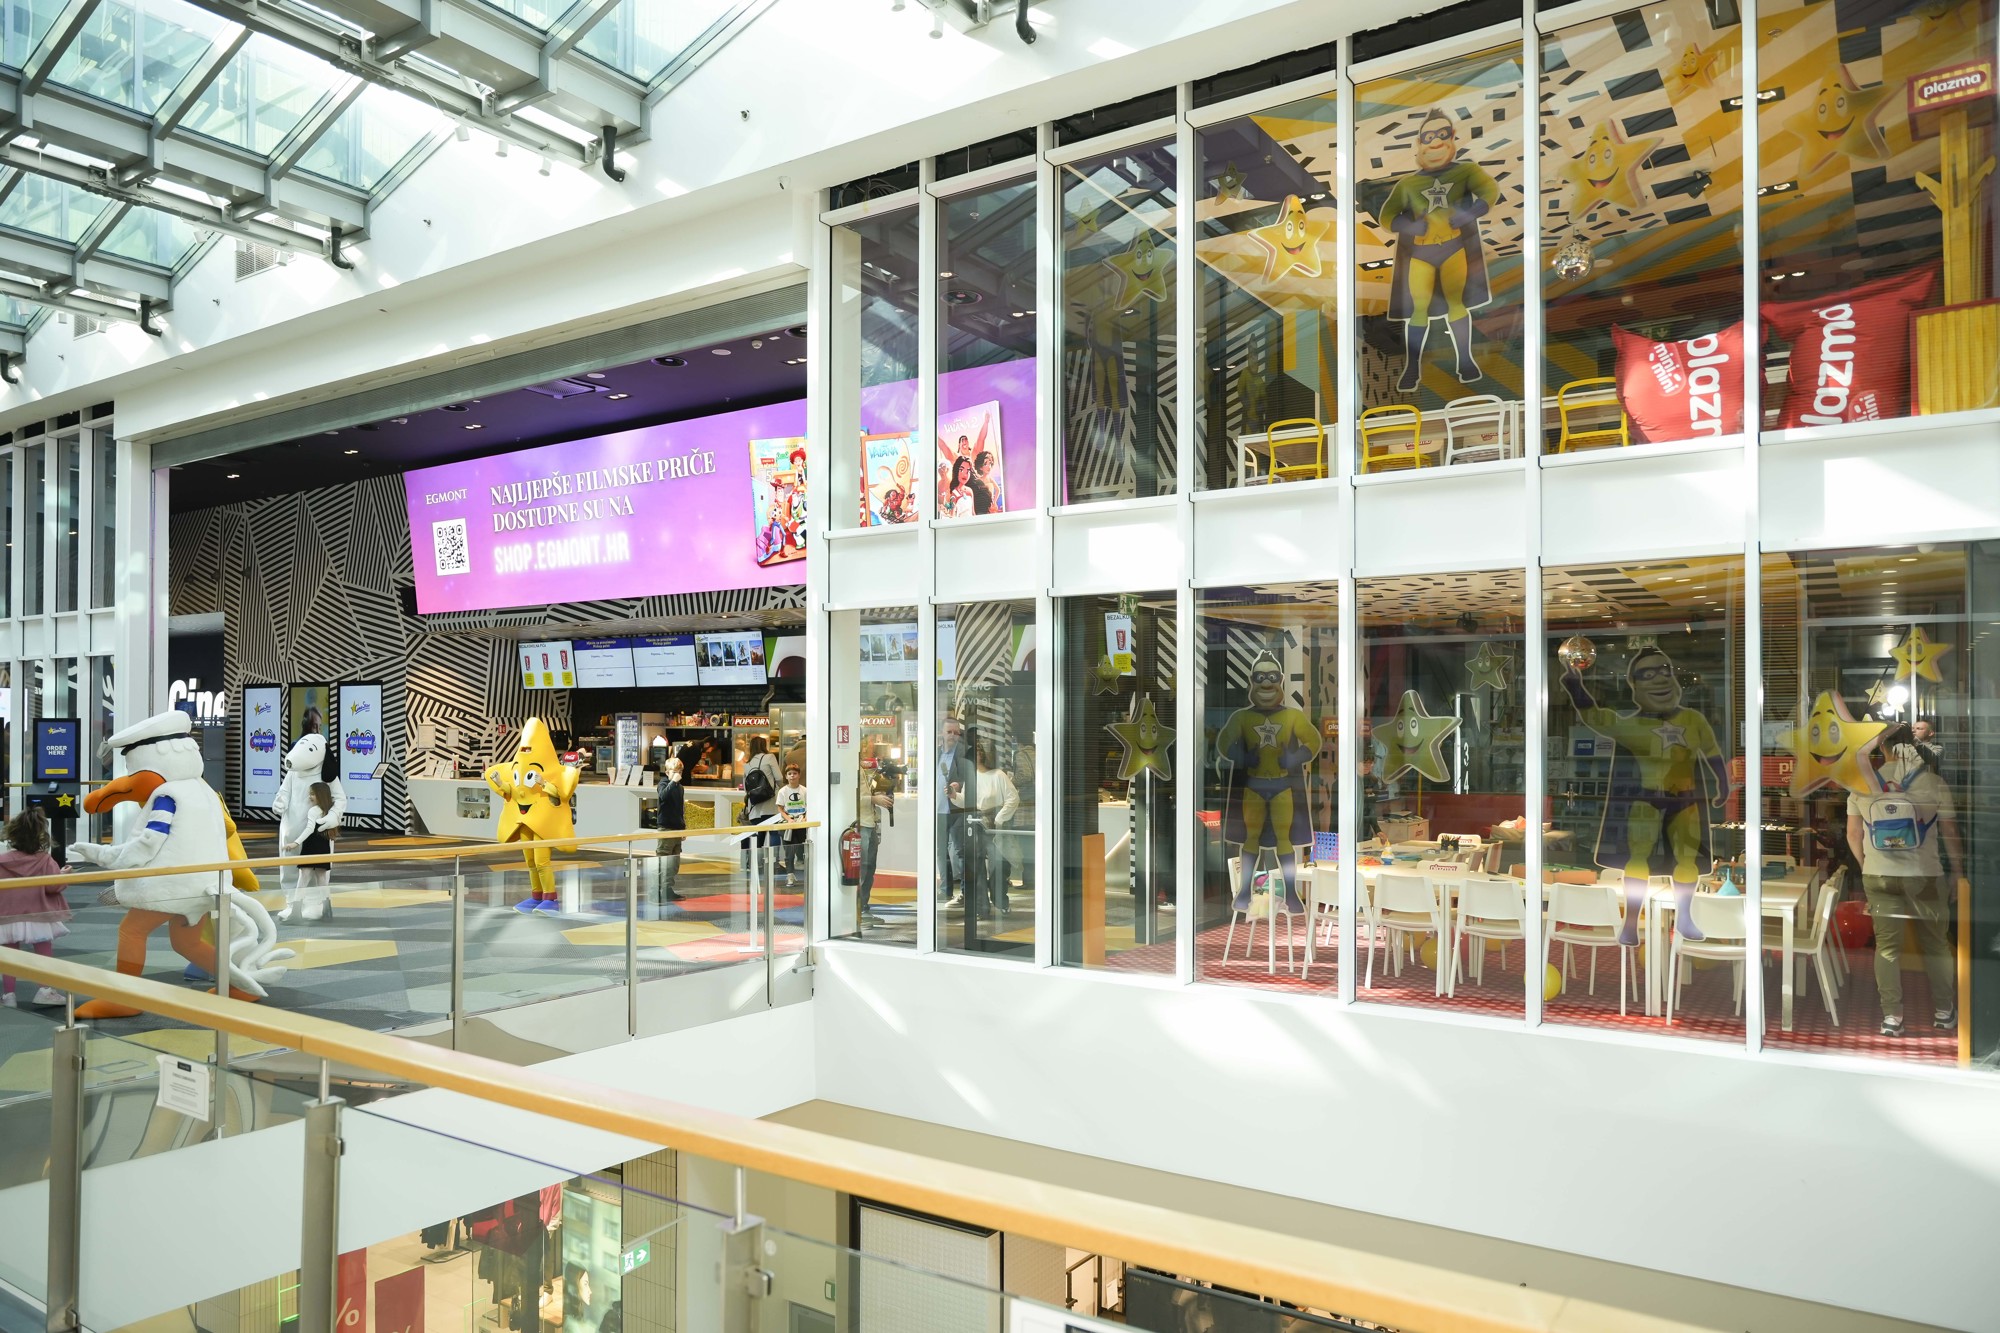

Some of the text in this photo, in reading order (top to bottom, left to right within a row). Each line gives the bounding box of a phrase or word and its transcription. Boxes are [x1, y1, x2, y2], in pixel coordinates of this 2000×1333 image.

[1923, 73, 1981, 98] plazma
[1653, 343, 1680, 375] mini
[1800, 303, 1856, 425] lazma
[1650, 362, 1679, 394] mini
[1679, 333, 1730, 437] plaz
[490, 447, 716, 508] NAJLJEPŠE FILMSKE PRIČE
[425, 488, 468, 505] EGMONT
[492, 494, 635, 533] DOSTUPNE SU NA
[493, 531, 631, 575] SHOP.EGMONT.HR
[735, 717, 770, 726] POPCORN
[860, 717, 892, 725] PCORN
